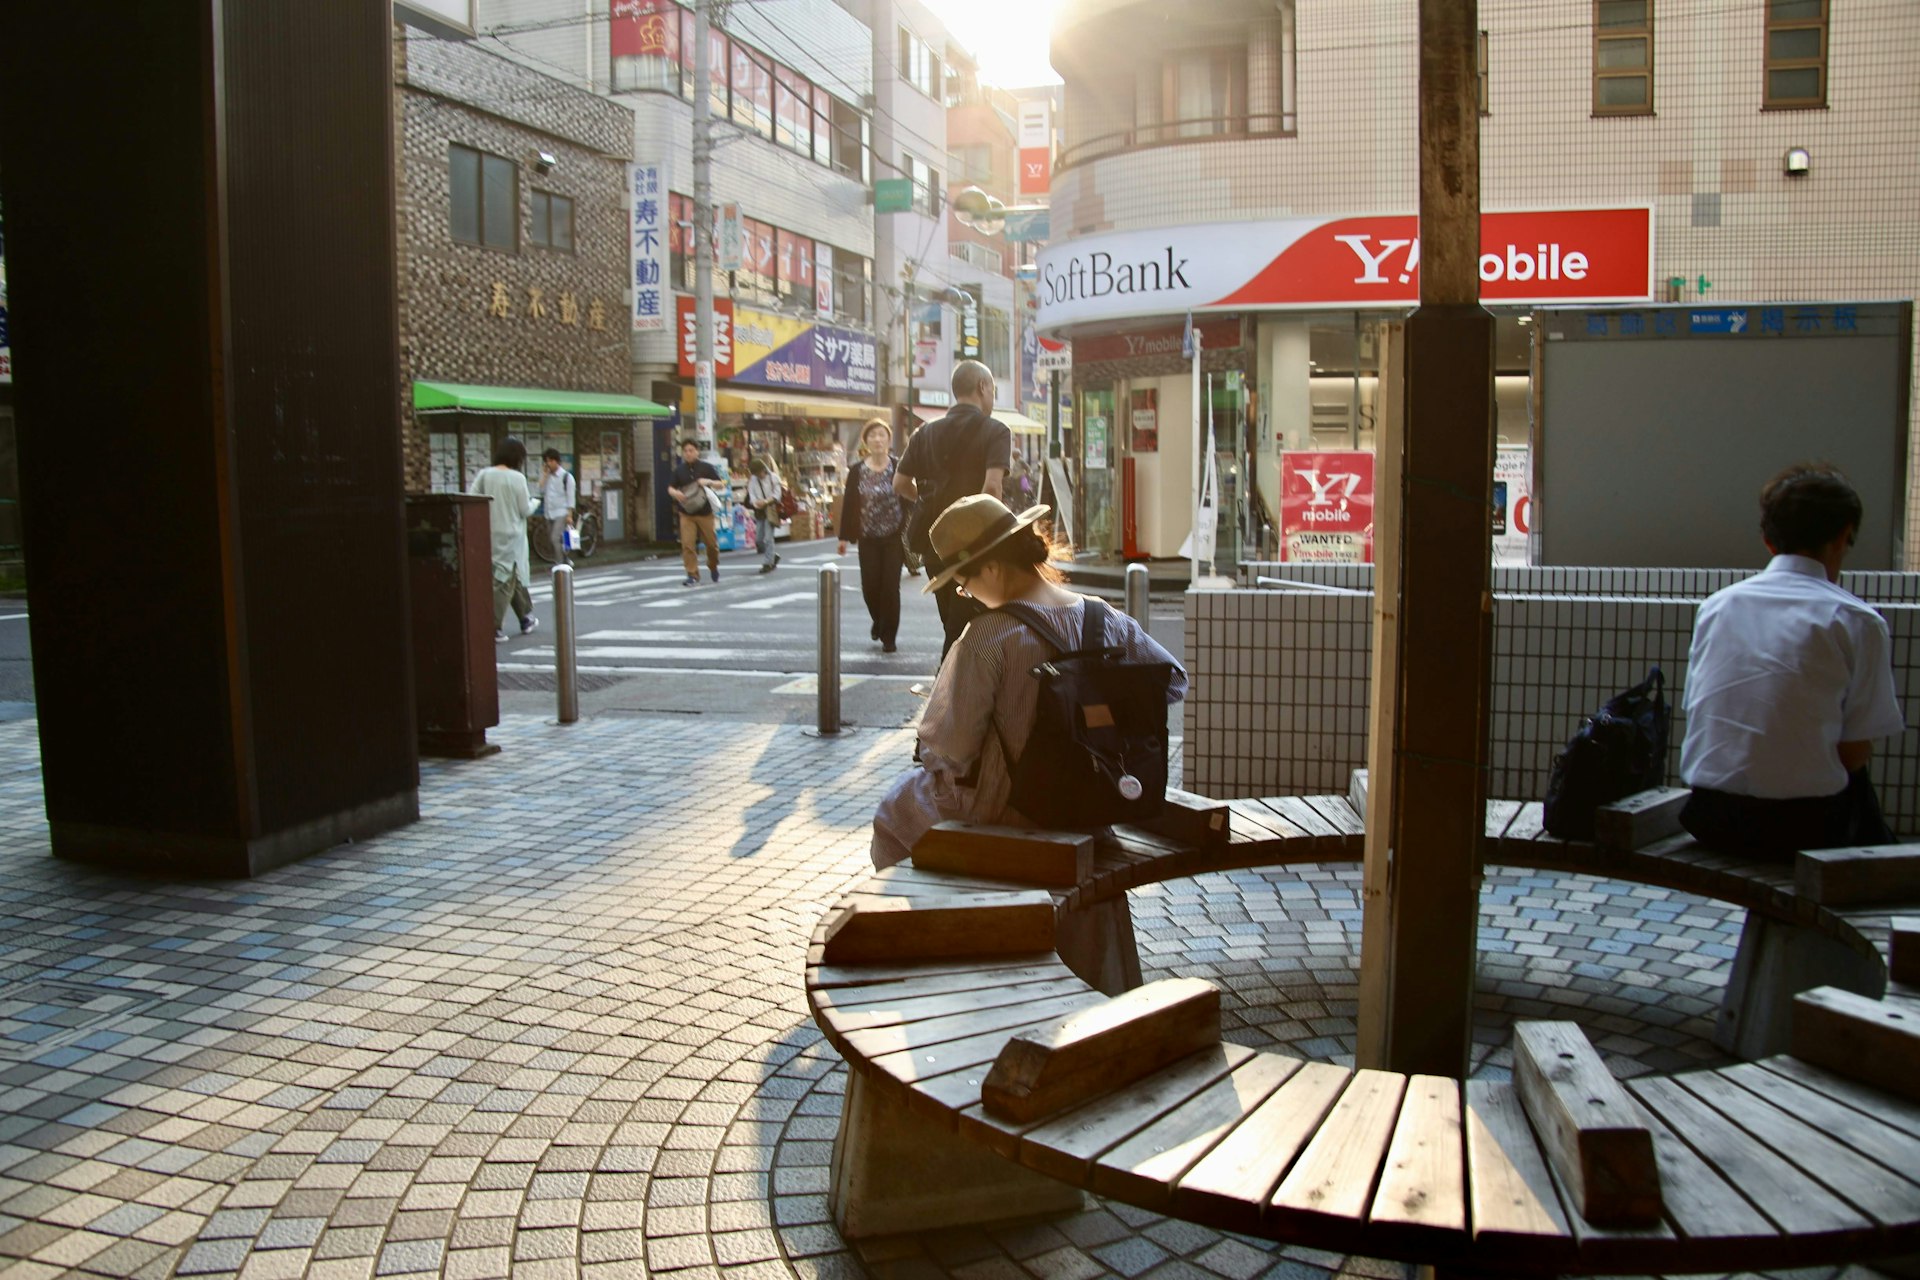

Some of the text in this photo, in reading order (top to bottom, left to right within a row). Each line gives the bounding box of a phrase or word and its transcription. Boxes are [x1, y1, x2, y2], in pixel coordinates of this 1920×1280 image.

[635, 199, 660, 316] 寿不動産
[1044, 245, 1192, 307] SoftBank
[1335, 234, 1589, 284] Y! obile
[815, 332, 876, 369] ミサワ薬局
[1294, 469, 1361, 511] Y!
[1302, 509, 1351, 522] mobile
[1300, 534, 1353, 545] WANTED
